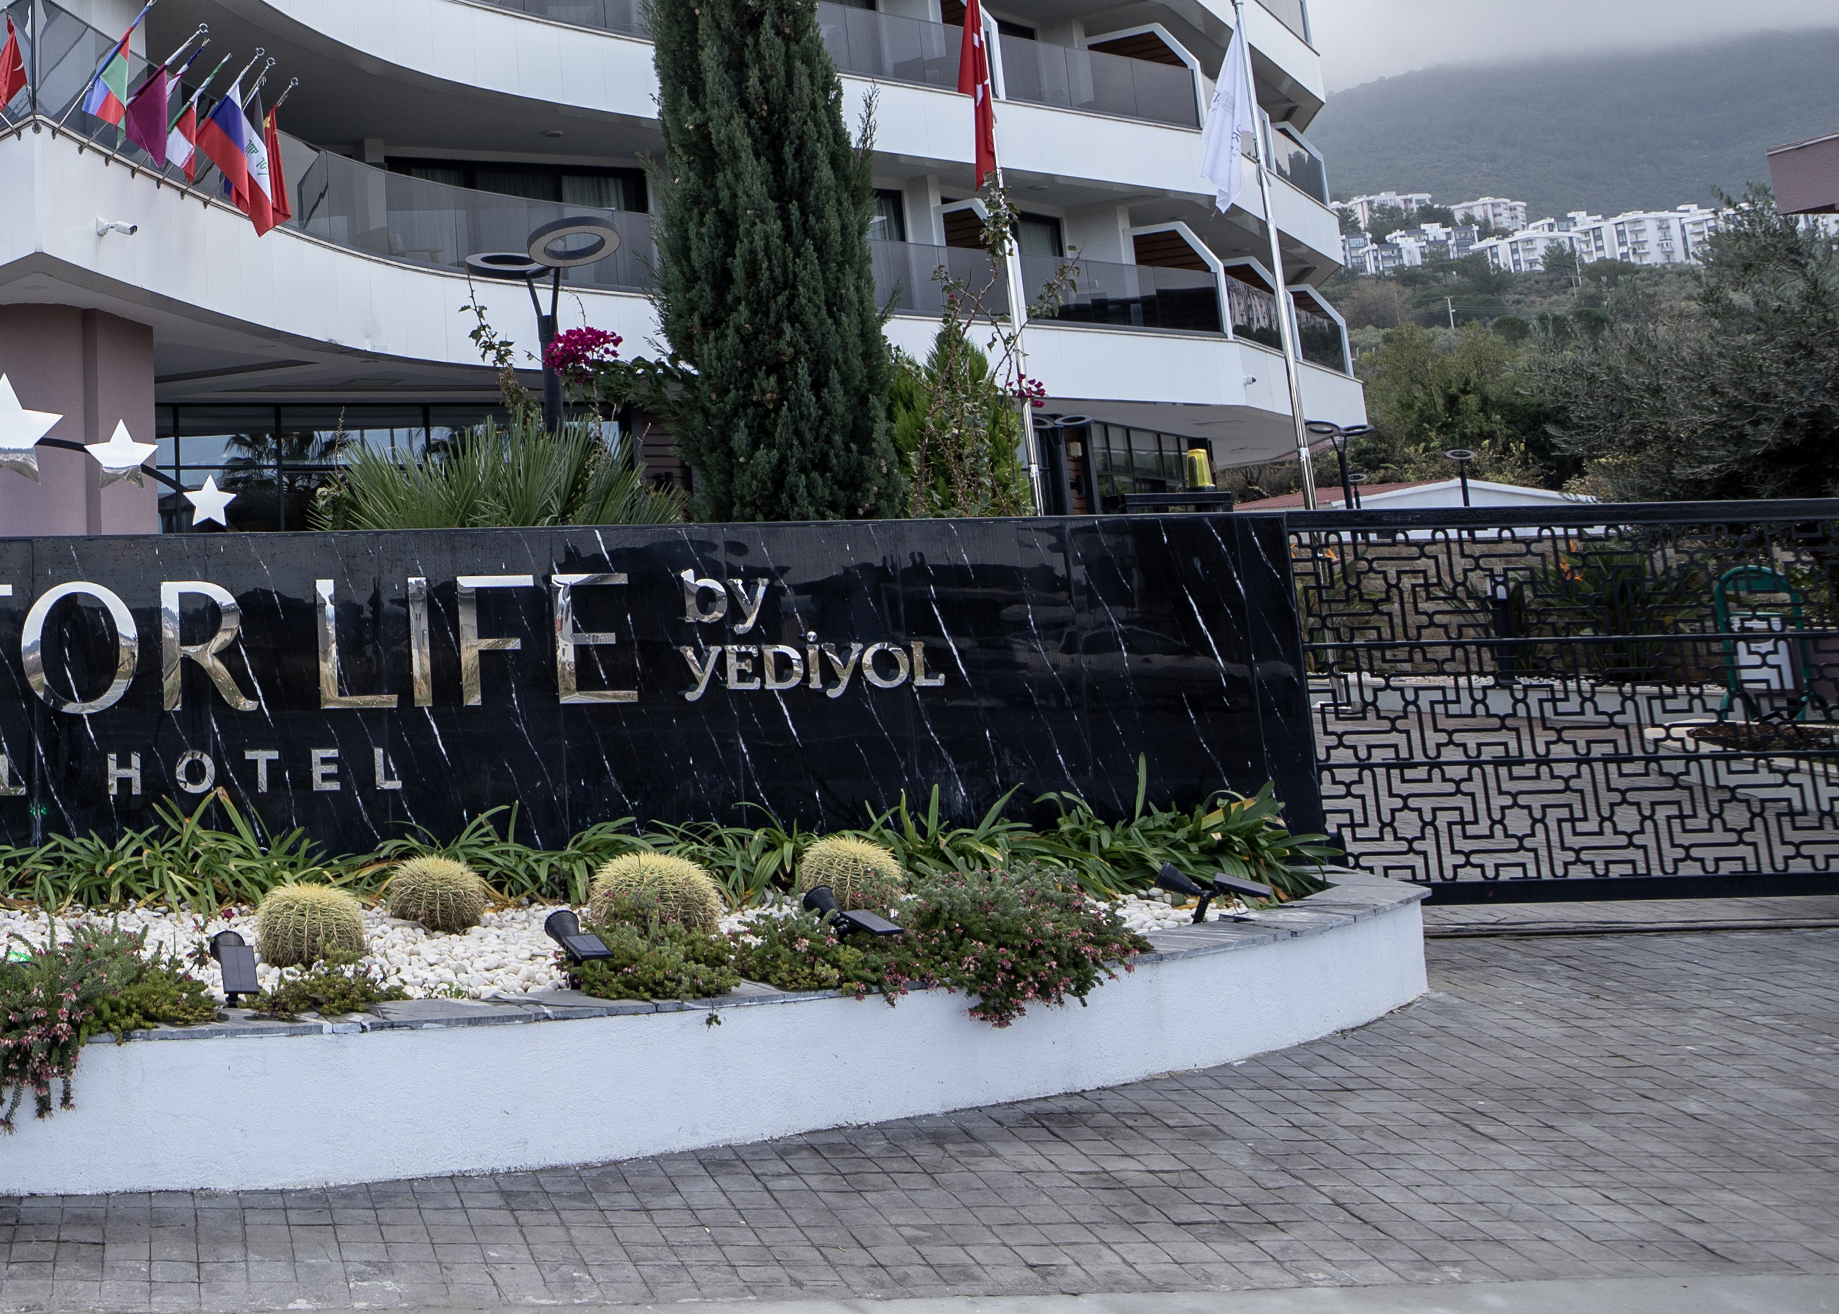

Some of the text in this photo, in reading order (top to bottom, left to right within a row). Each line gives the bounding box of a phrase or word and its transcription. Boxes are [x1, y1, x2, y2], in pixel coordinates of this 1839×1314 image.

[680, 568, 770, 635] by
[315, 573, 639, 710] LIFE
[107, 747, 402, 796] HOTEL
